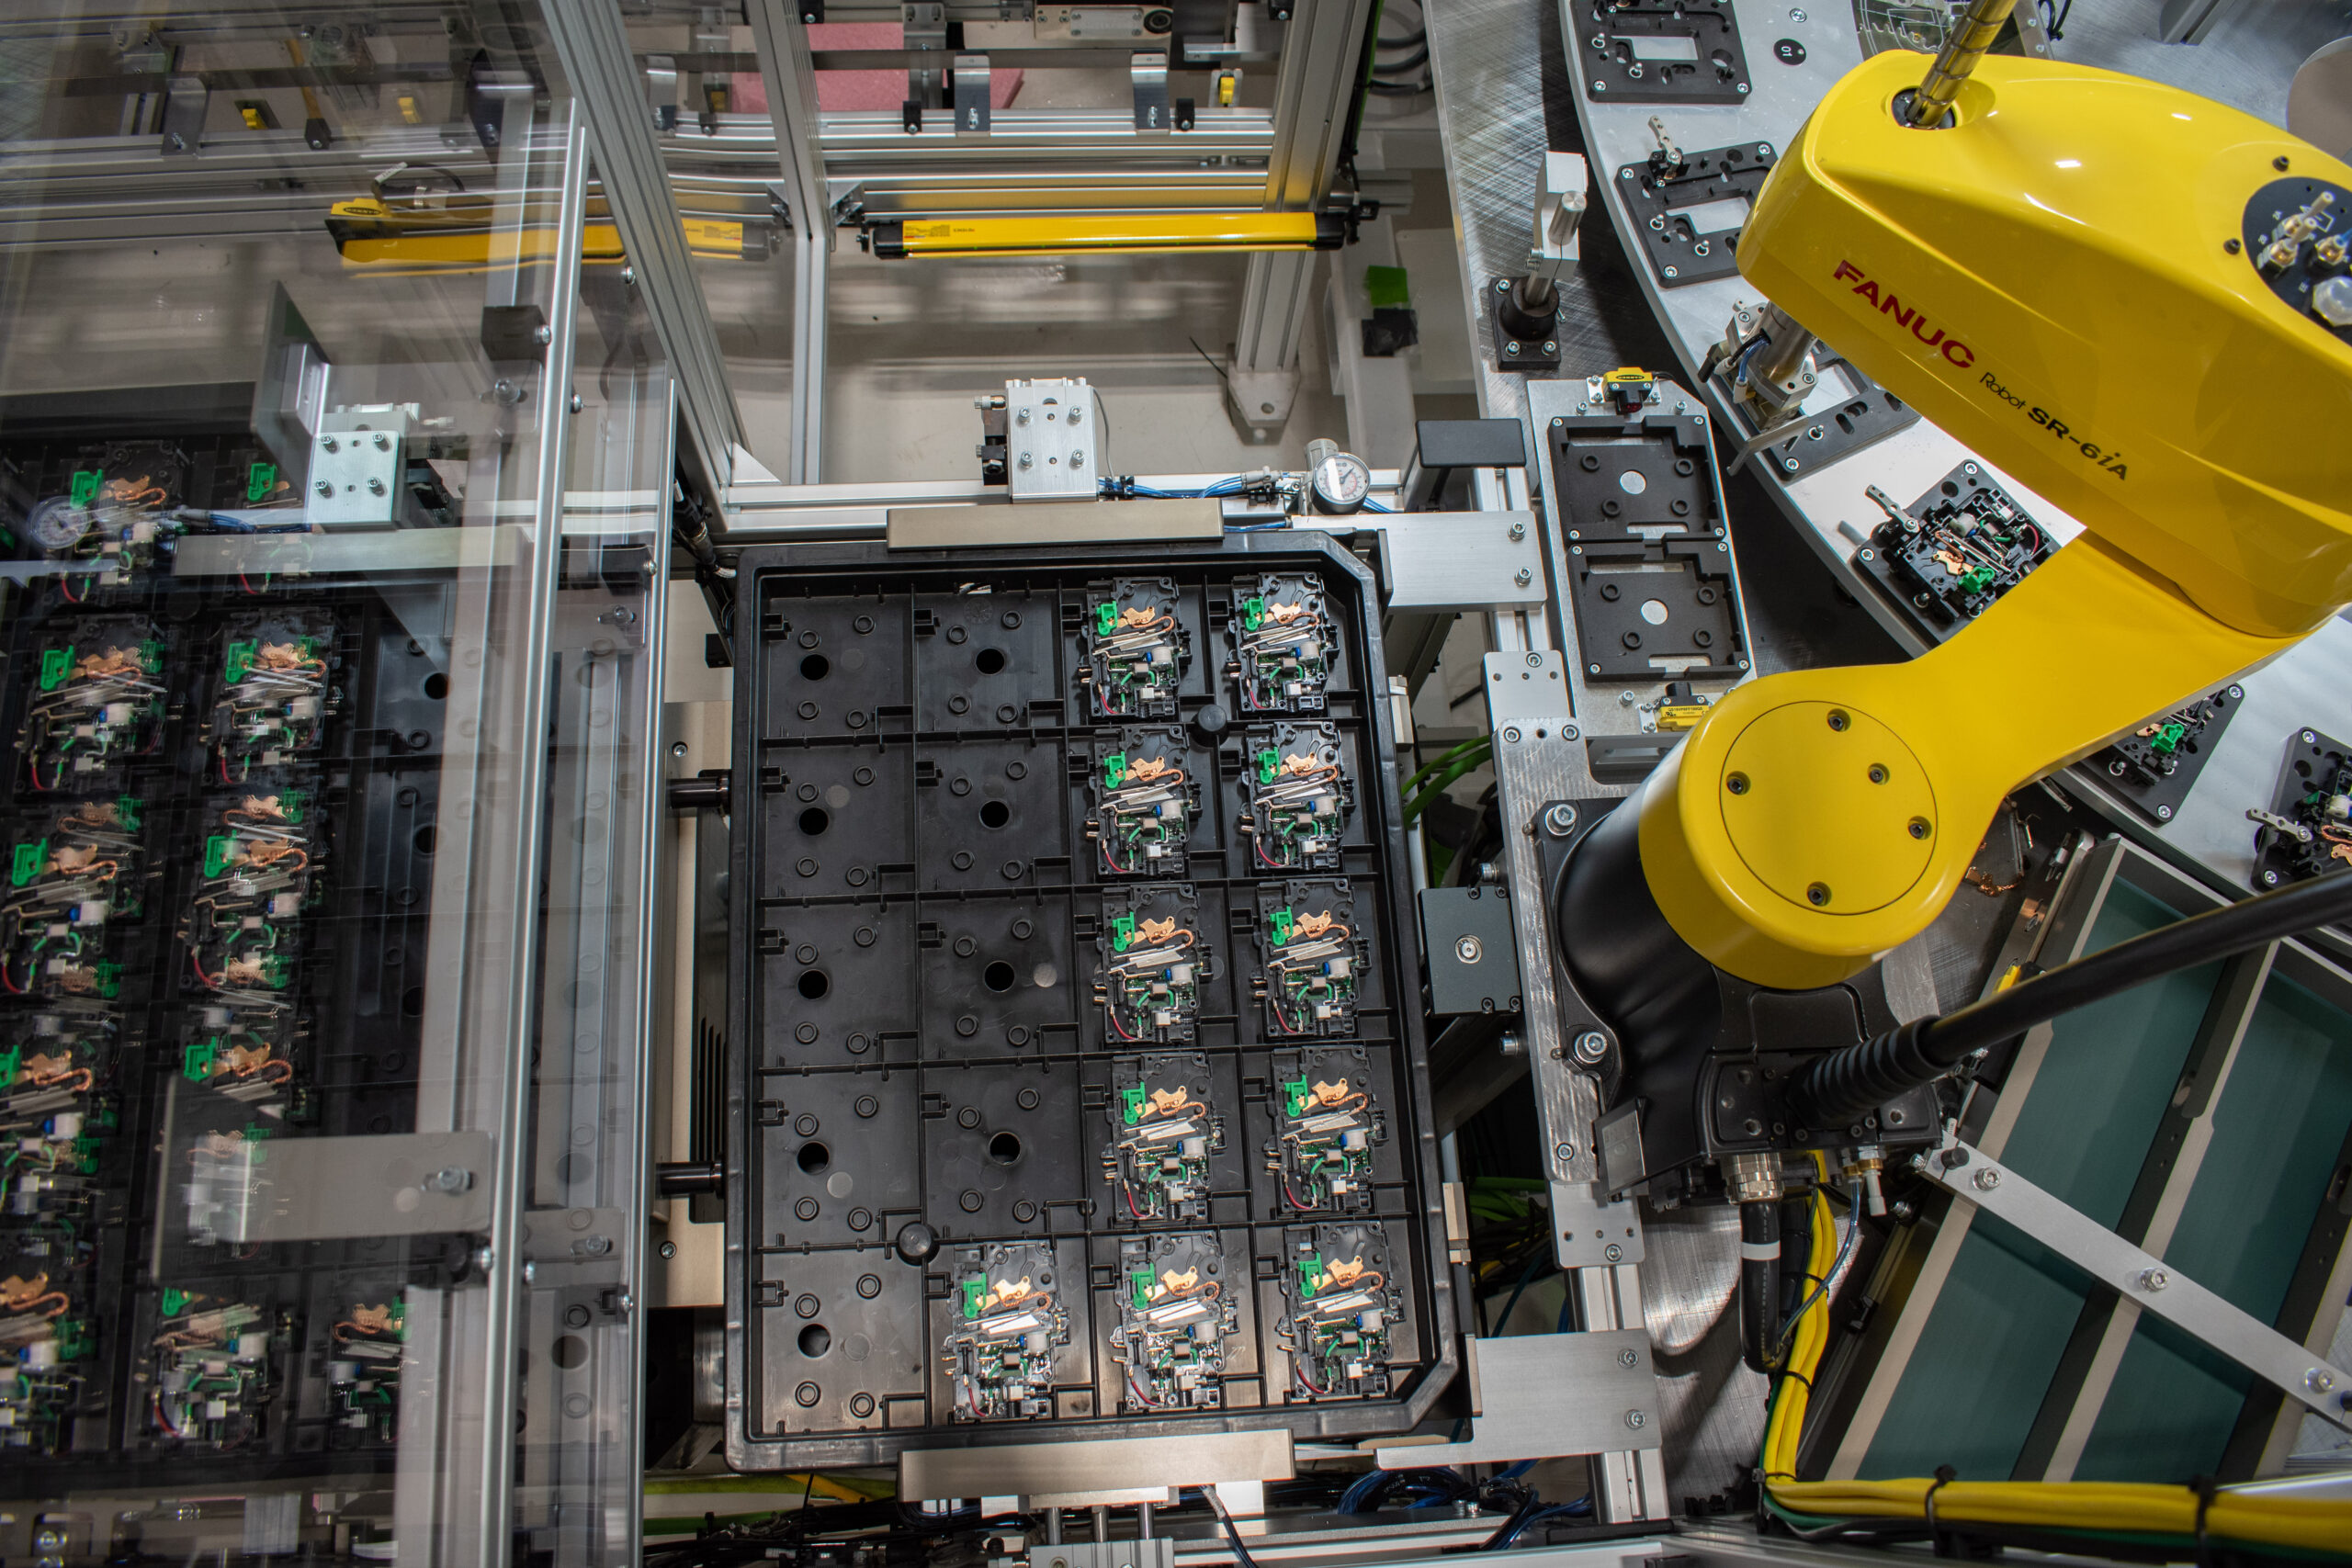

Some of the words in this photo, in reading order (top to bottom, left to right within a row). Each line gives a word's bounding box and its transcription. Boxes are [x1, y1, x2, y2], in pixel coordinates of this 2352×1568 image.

[1781, 46, 1792, 57] 01
[1833, 259, 1975, 368] FANUC
[1979, 371, 2027, 411] Robot
[2027, 406, 2128, 481] SR-6iA
